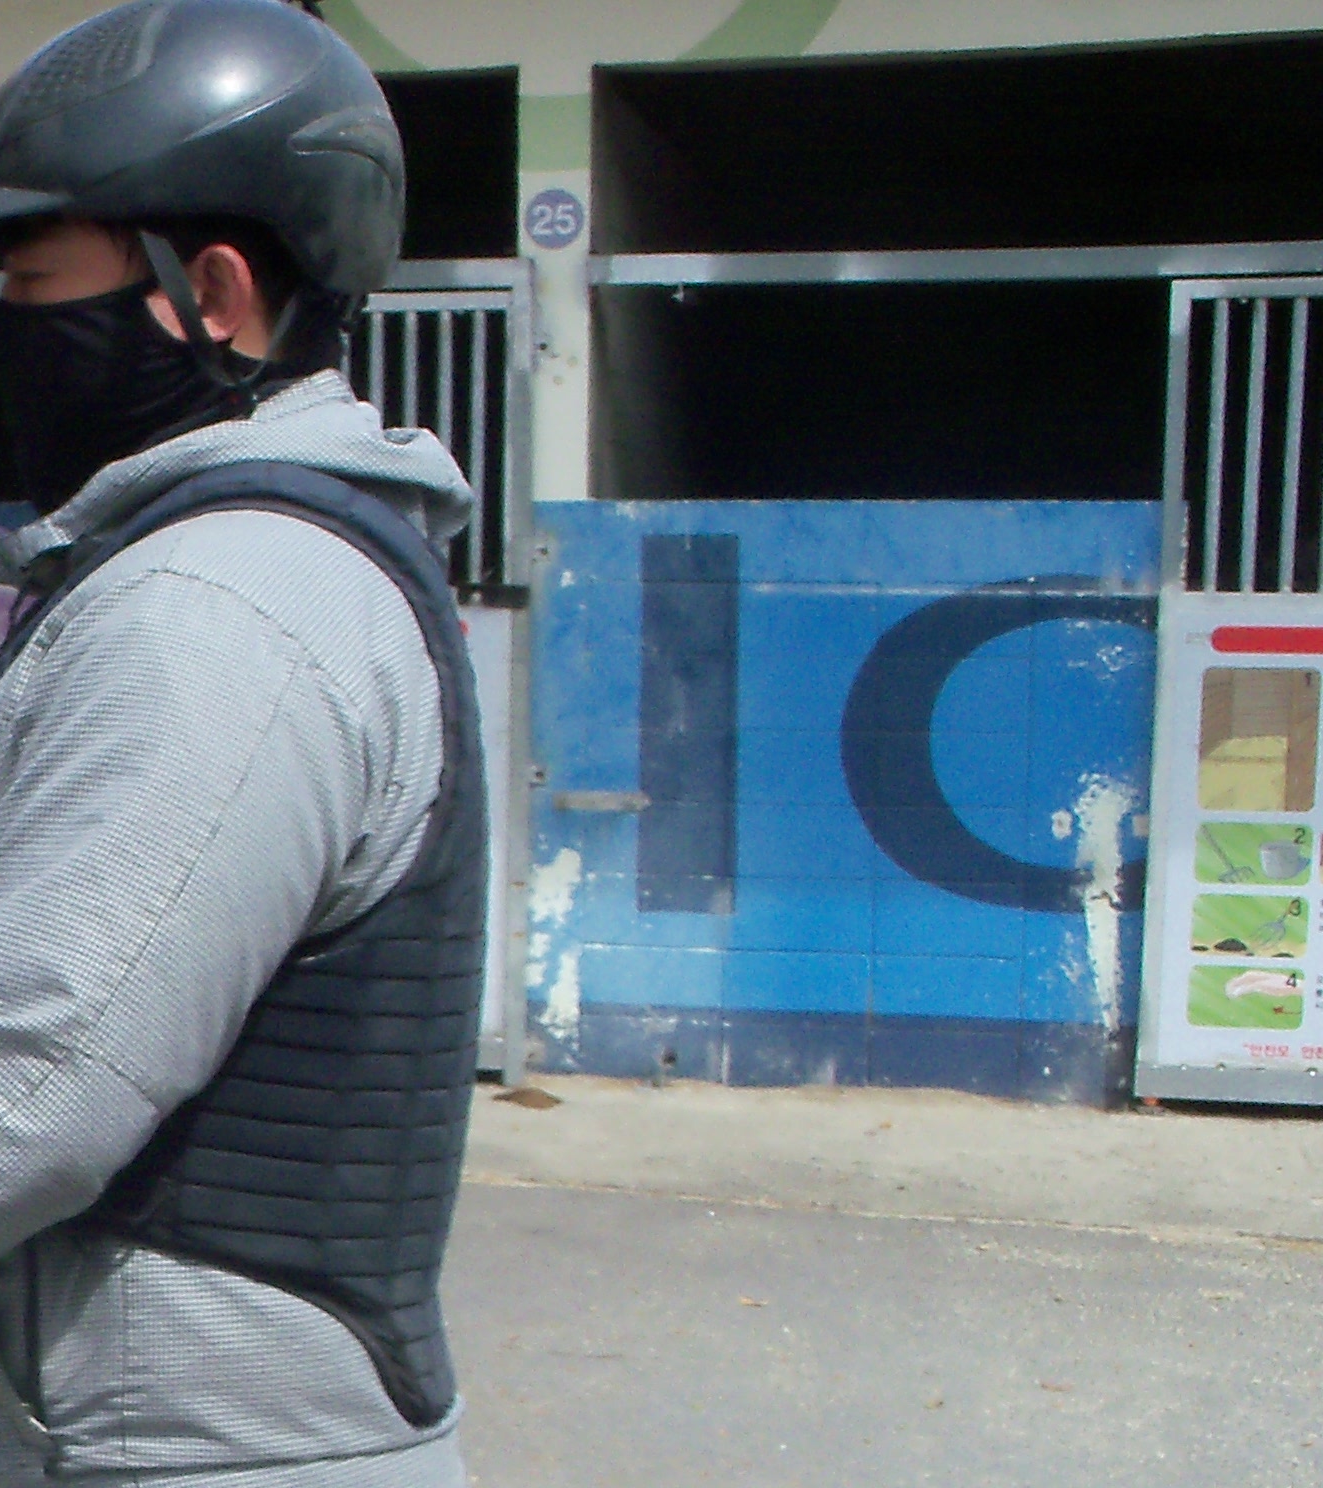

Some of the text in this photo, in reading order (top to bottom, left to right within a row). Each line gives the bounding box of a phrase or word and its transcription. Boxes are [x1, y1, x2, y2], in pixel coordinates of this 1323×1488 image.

[533, 204, 576, 235] 25
[1293, 827, 1306, 845] 2
[1289, 897, 1302, 916] 3
[1285, 973, 1297, 988] 4
